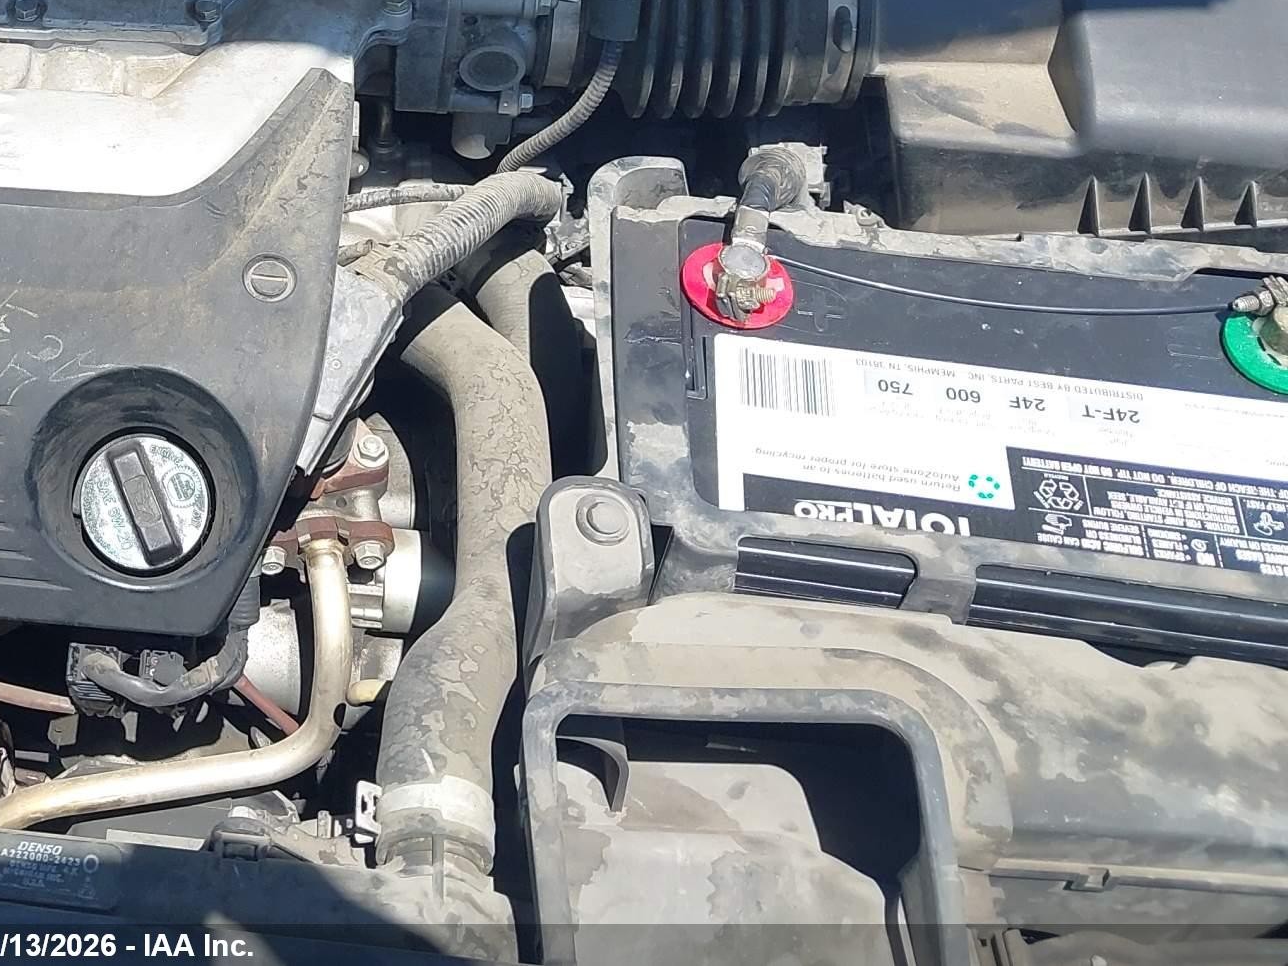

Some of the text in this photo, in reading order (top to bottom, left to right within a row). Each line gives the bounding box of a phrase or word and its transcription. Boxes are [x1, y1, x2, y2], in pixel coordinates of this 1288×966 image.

[877, 379, 913, 396] 750
[945, 387, 981, 403] 600
[1008, 396, 1046, 412] 24F
[1081, 404, 1141, 424] 24F-T
[921, 478, 961, 492] Return
[17, 841, 63, 855] DENSO
